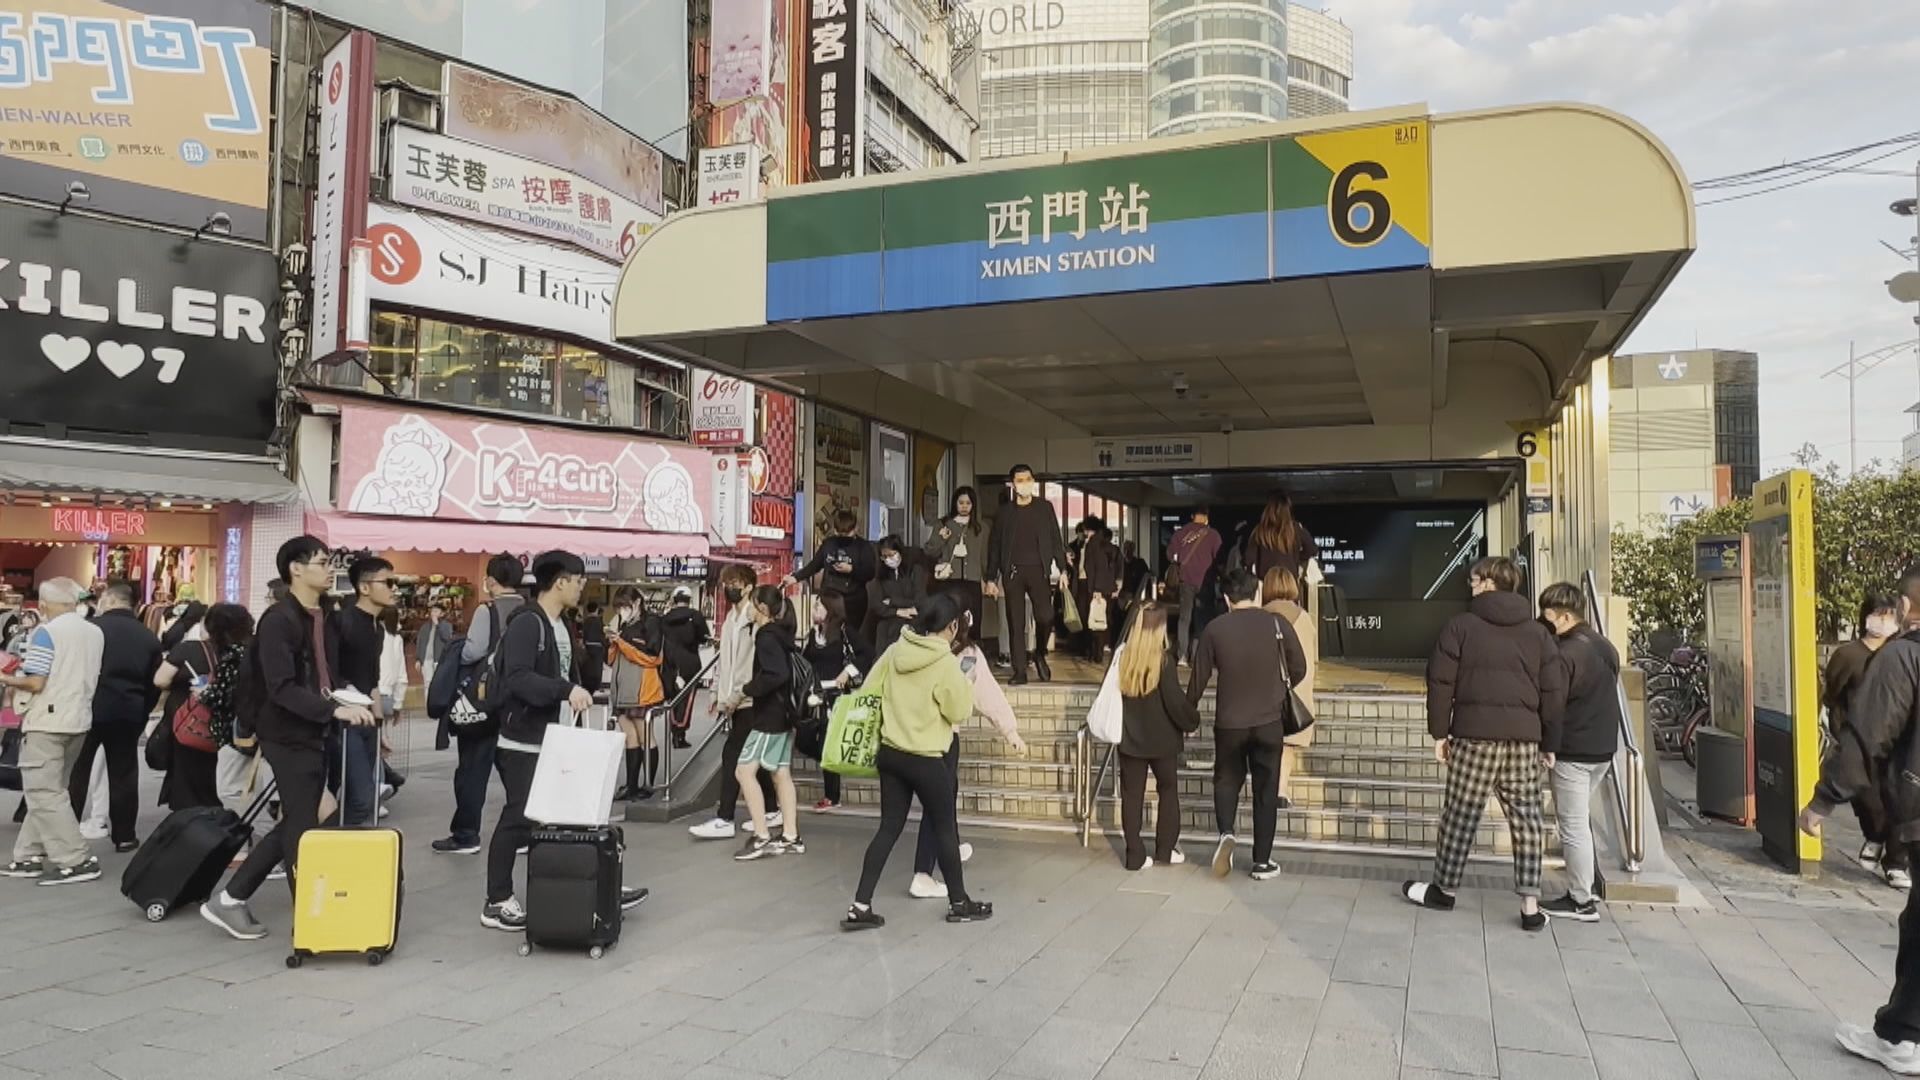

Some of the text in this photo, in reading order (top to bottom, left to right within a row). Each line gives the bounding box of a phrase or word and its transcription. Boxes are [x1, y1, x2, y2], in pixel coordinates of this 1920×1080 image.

[0, 107, 132, 127] EN-WALKER
[1395, 126, 1418, 141] 出入口
[406, 143, 487, 193] 玉芙蓉
[704, 152, 746, 173] 玉芙蓉
[492, 177, 515, 190] SPA
[521, 175, 573, 205] 按摩
[578, 191, 613, 223] 護膚
[985, 182, 1151, 249] 西門站
[1329, 161, 1391, 246] 6
[981, 243, 1155, 280] XIMEN STATION
[151, 346, 186, 384] 7
[1517, 431, 1537, 457] 6
[54, 508, 145, 535] KILLER
[753, 500, 793, 534] STONE
[842, 728, 863, 745] LO
[841, 744, 860, 765] VE
